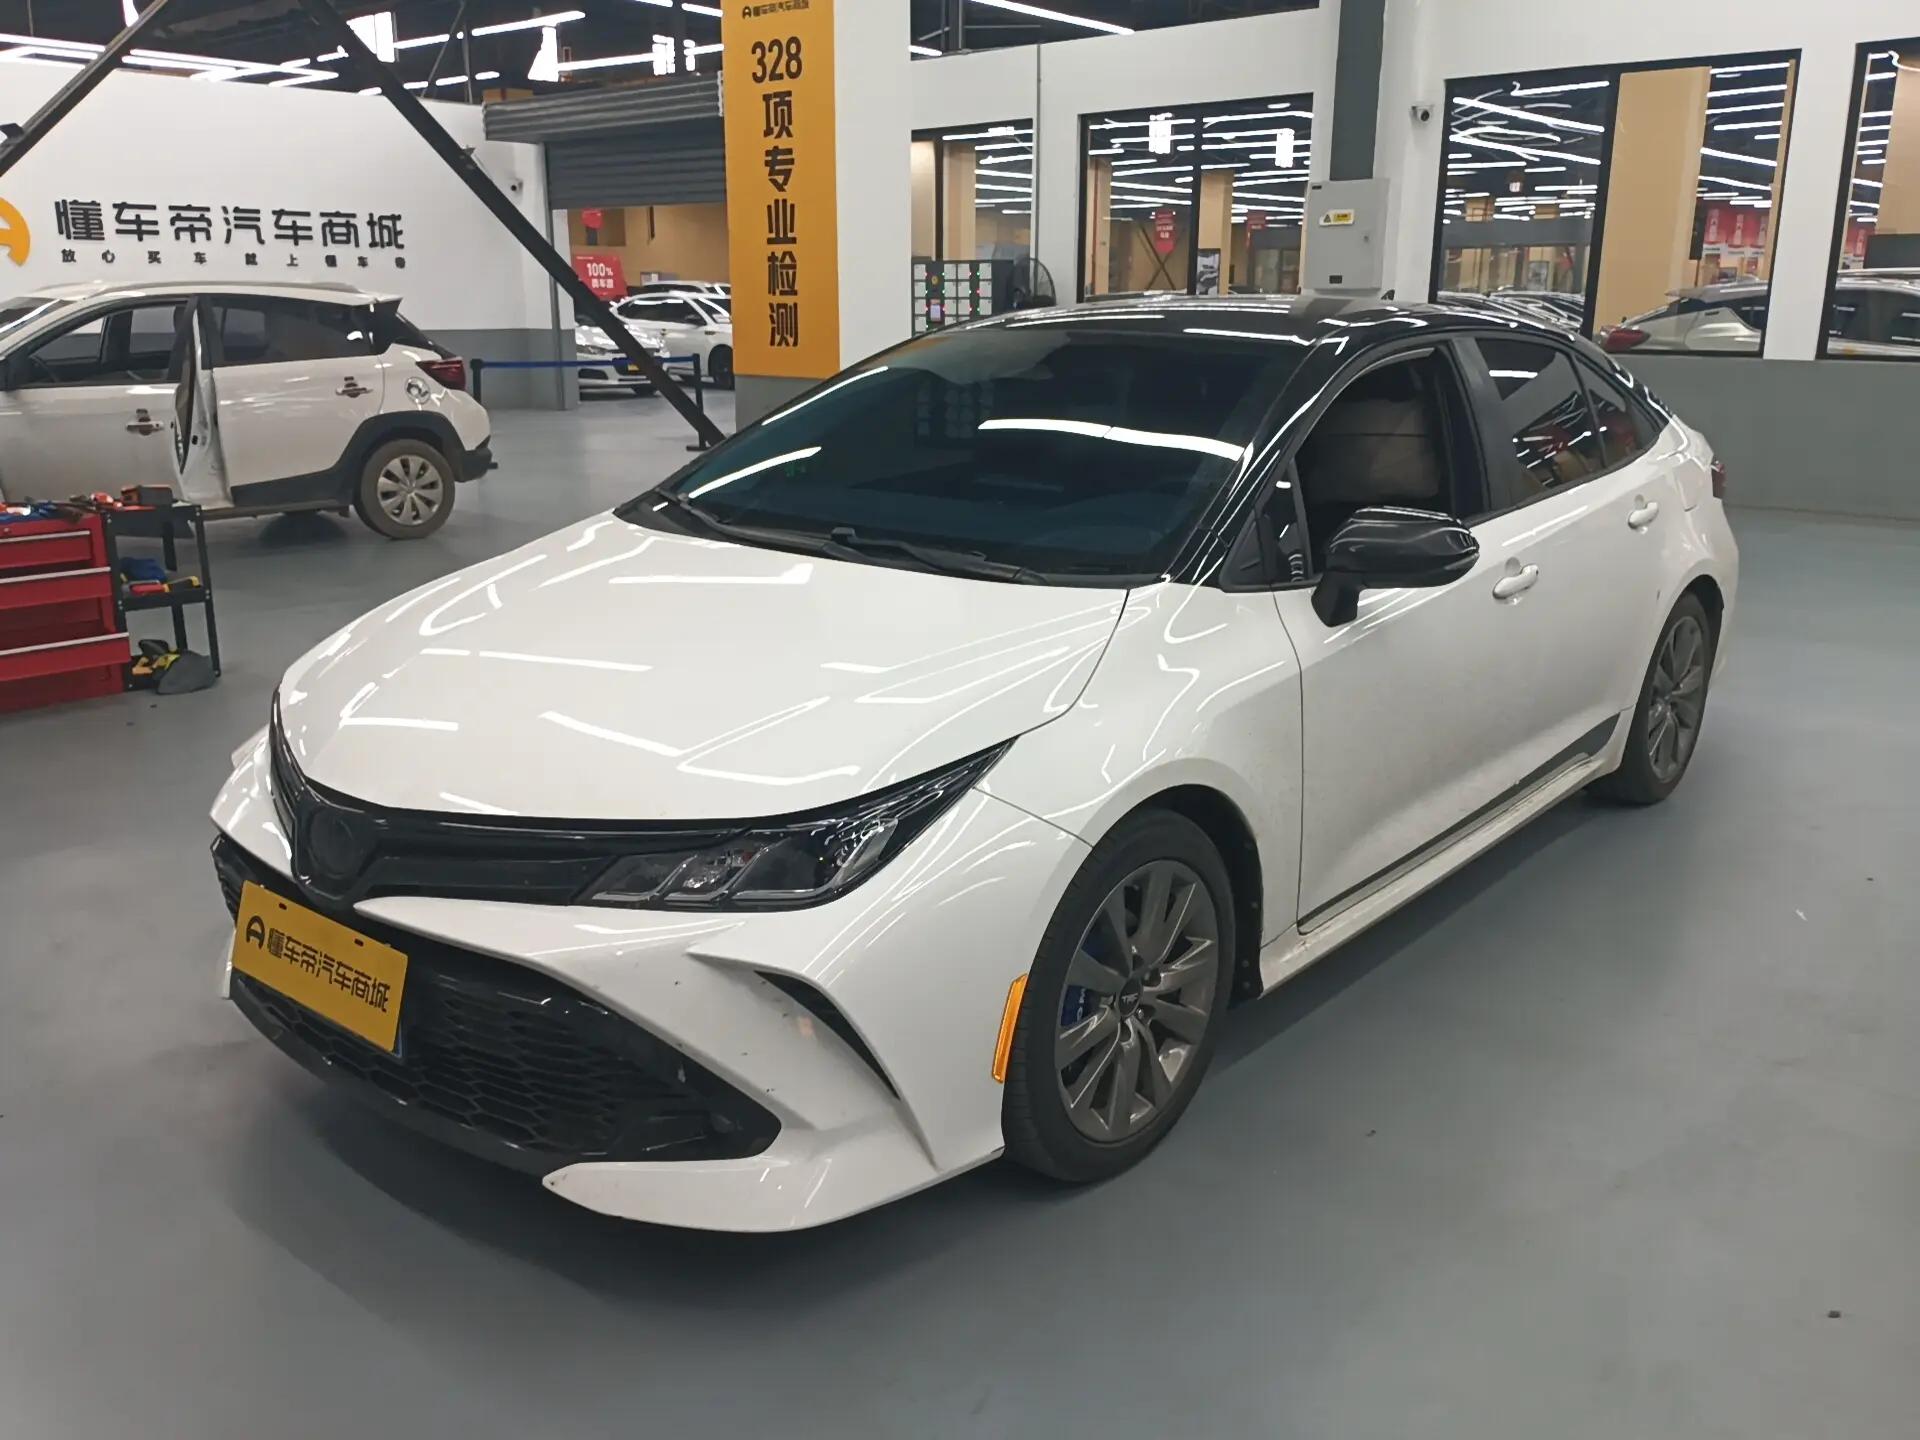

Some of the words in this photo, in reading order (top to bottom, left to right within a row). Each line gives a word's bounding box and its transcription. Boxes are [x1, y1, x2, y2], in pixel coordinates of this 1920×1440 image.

[751, 36, 802, 84] 328
[54, 198, 405, 250] 懂车帝汽车商城
[61, 248, 406, 269] 放心买车上车
[267, 927, 391, 1013] 懂车帝汽车商城
